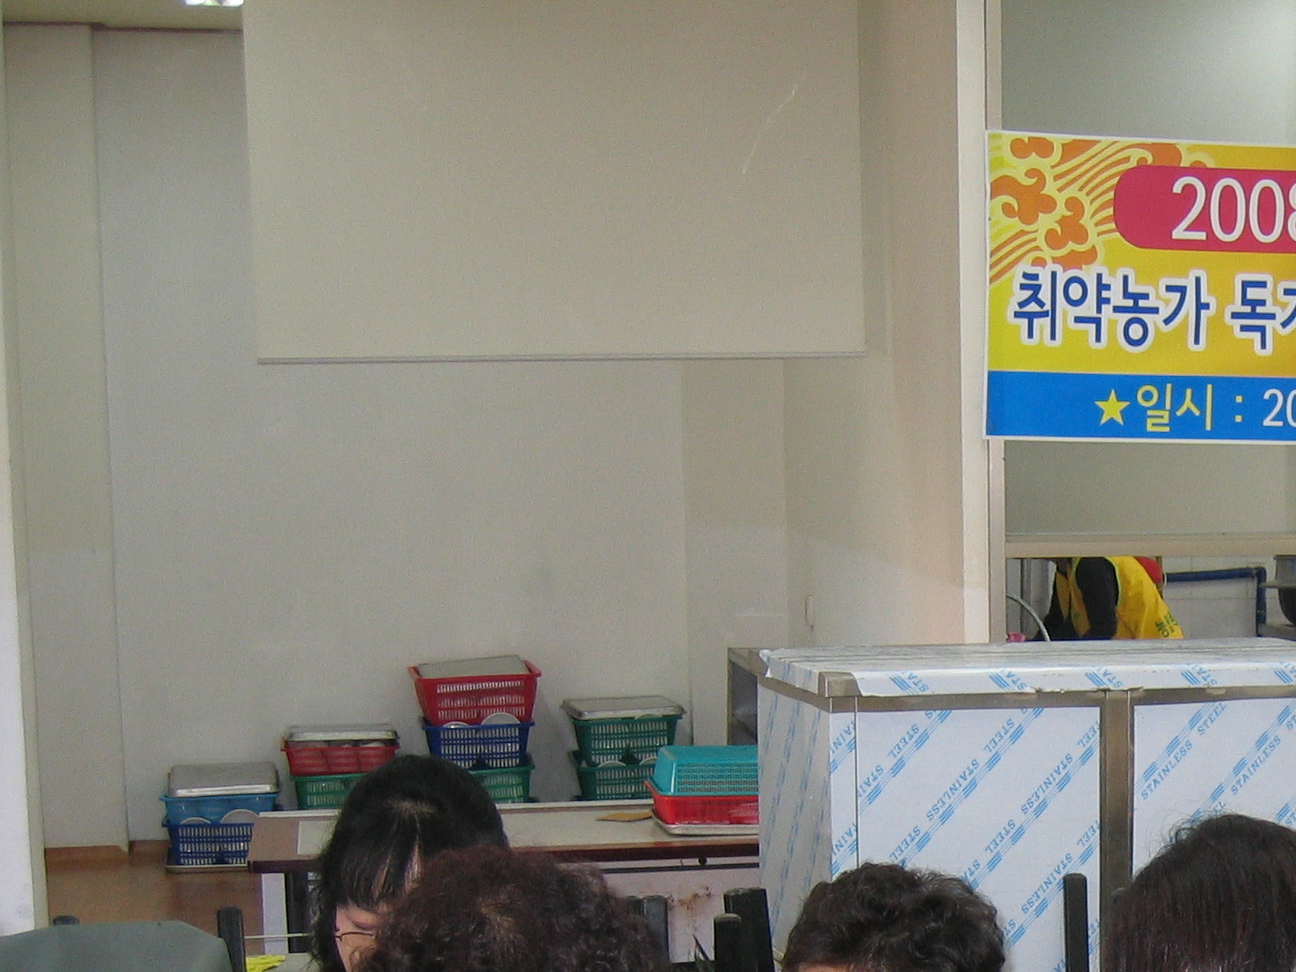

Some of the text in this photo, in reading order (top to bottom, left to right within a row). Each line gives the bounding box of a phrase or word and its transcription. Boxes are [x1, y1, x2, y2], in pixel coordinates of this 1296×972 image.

[1011, 269, 1211, 347] 취약농가
[1136, 382, 1214, 433] 일시
[888, 723, 920, 759] STEEL
[983, 717, 1015, 754] STEEL
[1140, 702, 1227, 801] STAINLESS STEEL
[1230, 735, 1282, 796] STAINLESS
[925, 758, 980, 822] STAINLESS
[1019, 753, 1074, 816] STAINLESS
[889, 825, 921, 861] STEEL
[985, 819, 1016, 854] STEEL
[1020, 852, 1073, 915] STAINLESS
